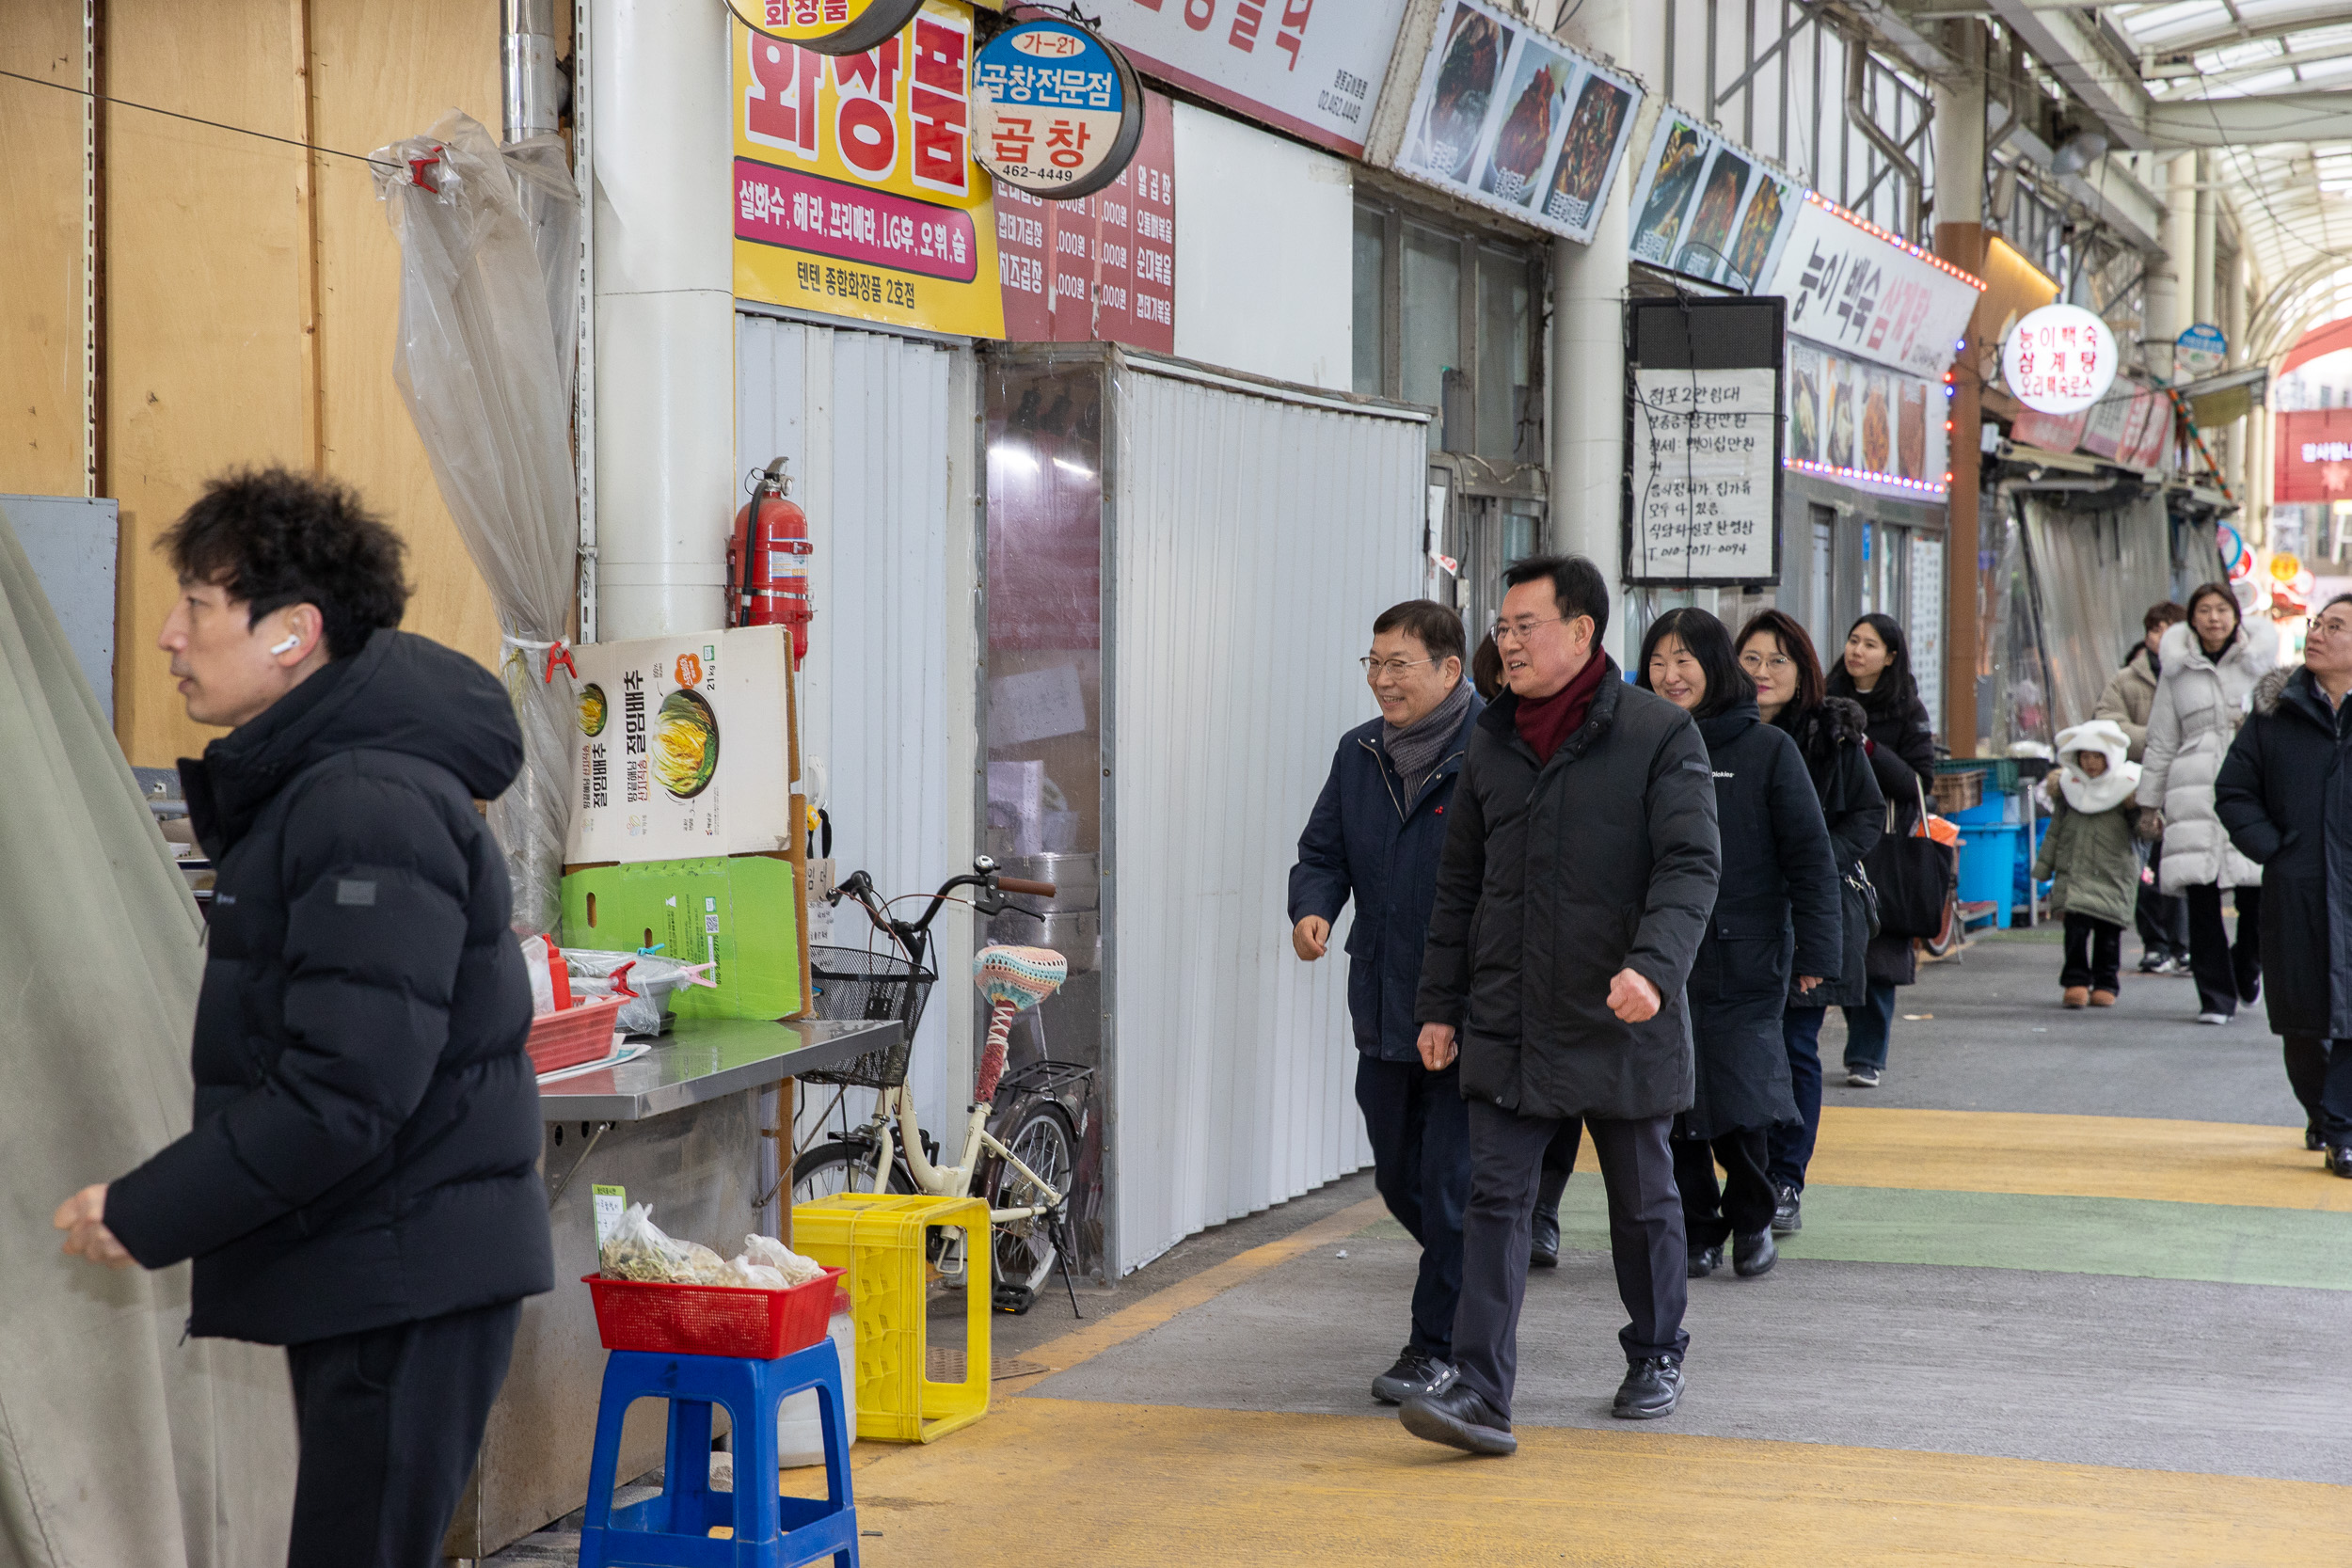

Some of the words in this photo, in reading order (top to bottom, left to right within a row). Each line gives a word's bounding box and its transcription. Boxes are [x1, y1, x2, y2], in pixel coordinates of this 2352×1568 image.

[765, 0, 848, 26] 화장품
[1024, 33, 1075, 55] 가-21
[748, 17, 967, 189] 화장품
[975, 62, 1113, 107] 곱창전문점
[992, 116, 1091, 168] 곱창
[1002, 165, 1073, 181] 462-4449
[739, 180, 790, 230] 설화수,
[793, 191, 828, 237] 헤라,
[998, 211, 1042, 248] 껍데기곱창
[797, 261, 821, 293] 텐텐
[824, 266, 882, 304] 종합화장품
[886, 279, 915, 309] 2호점
[1136, 245, 1172, 287] 순대볶음
[1136, 293, 1171, 325] 껍데기볶음
[1791, 237, 1882, 345] 능이백숙
[1866, 275, 1932, 362] 삼계탕
[2019, 325, 2098, 351] 능이백숙
[2019, 351, 2097, 374] 삼계탕
[2021, 375, 2093, 399] 오리백숙로스
[707, 665, 716, 676] kg
[707, 675, 715, 690] 21
[623, 669, 647, 755] 절임배추
[593, 742, 607, 809] 절임배추
[627, 760, 638, 803] 땅끝해남
[637, 759, 648, 802] 산지직송
[1711, 770, 1734, 779] Dickies
